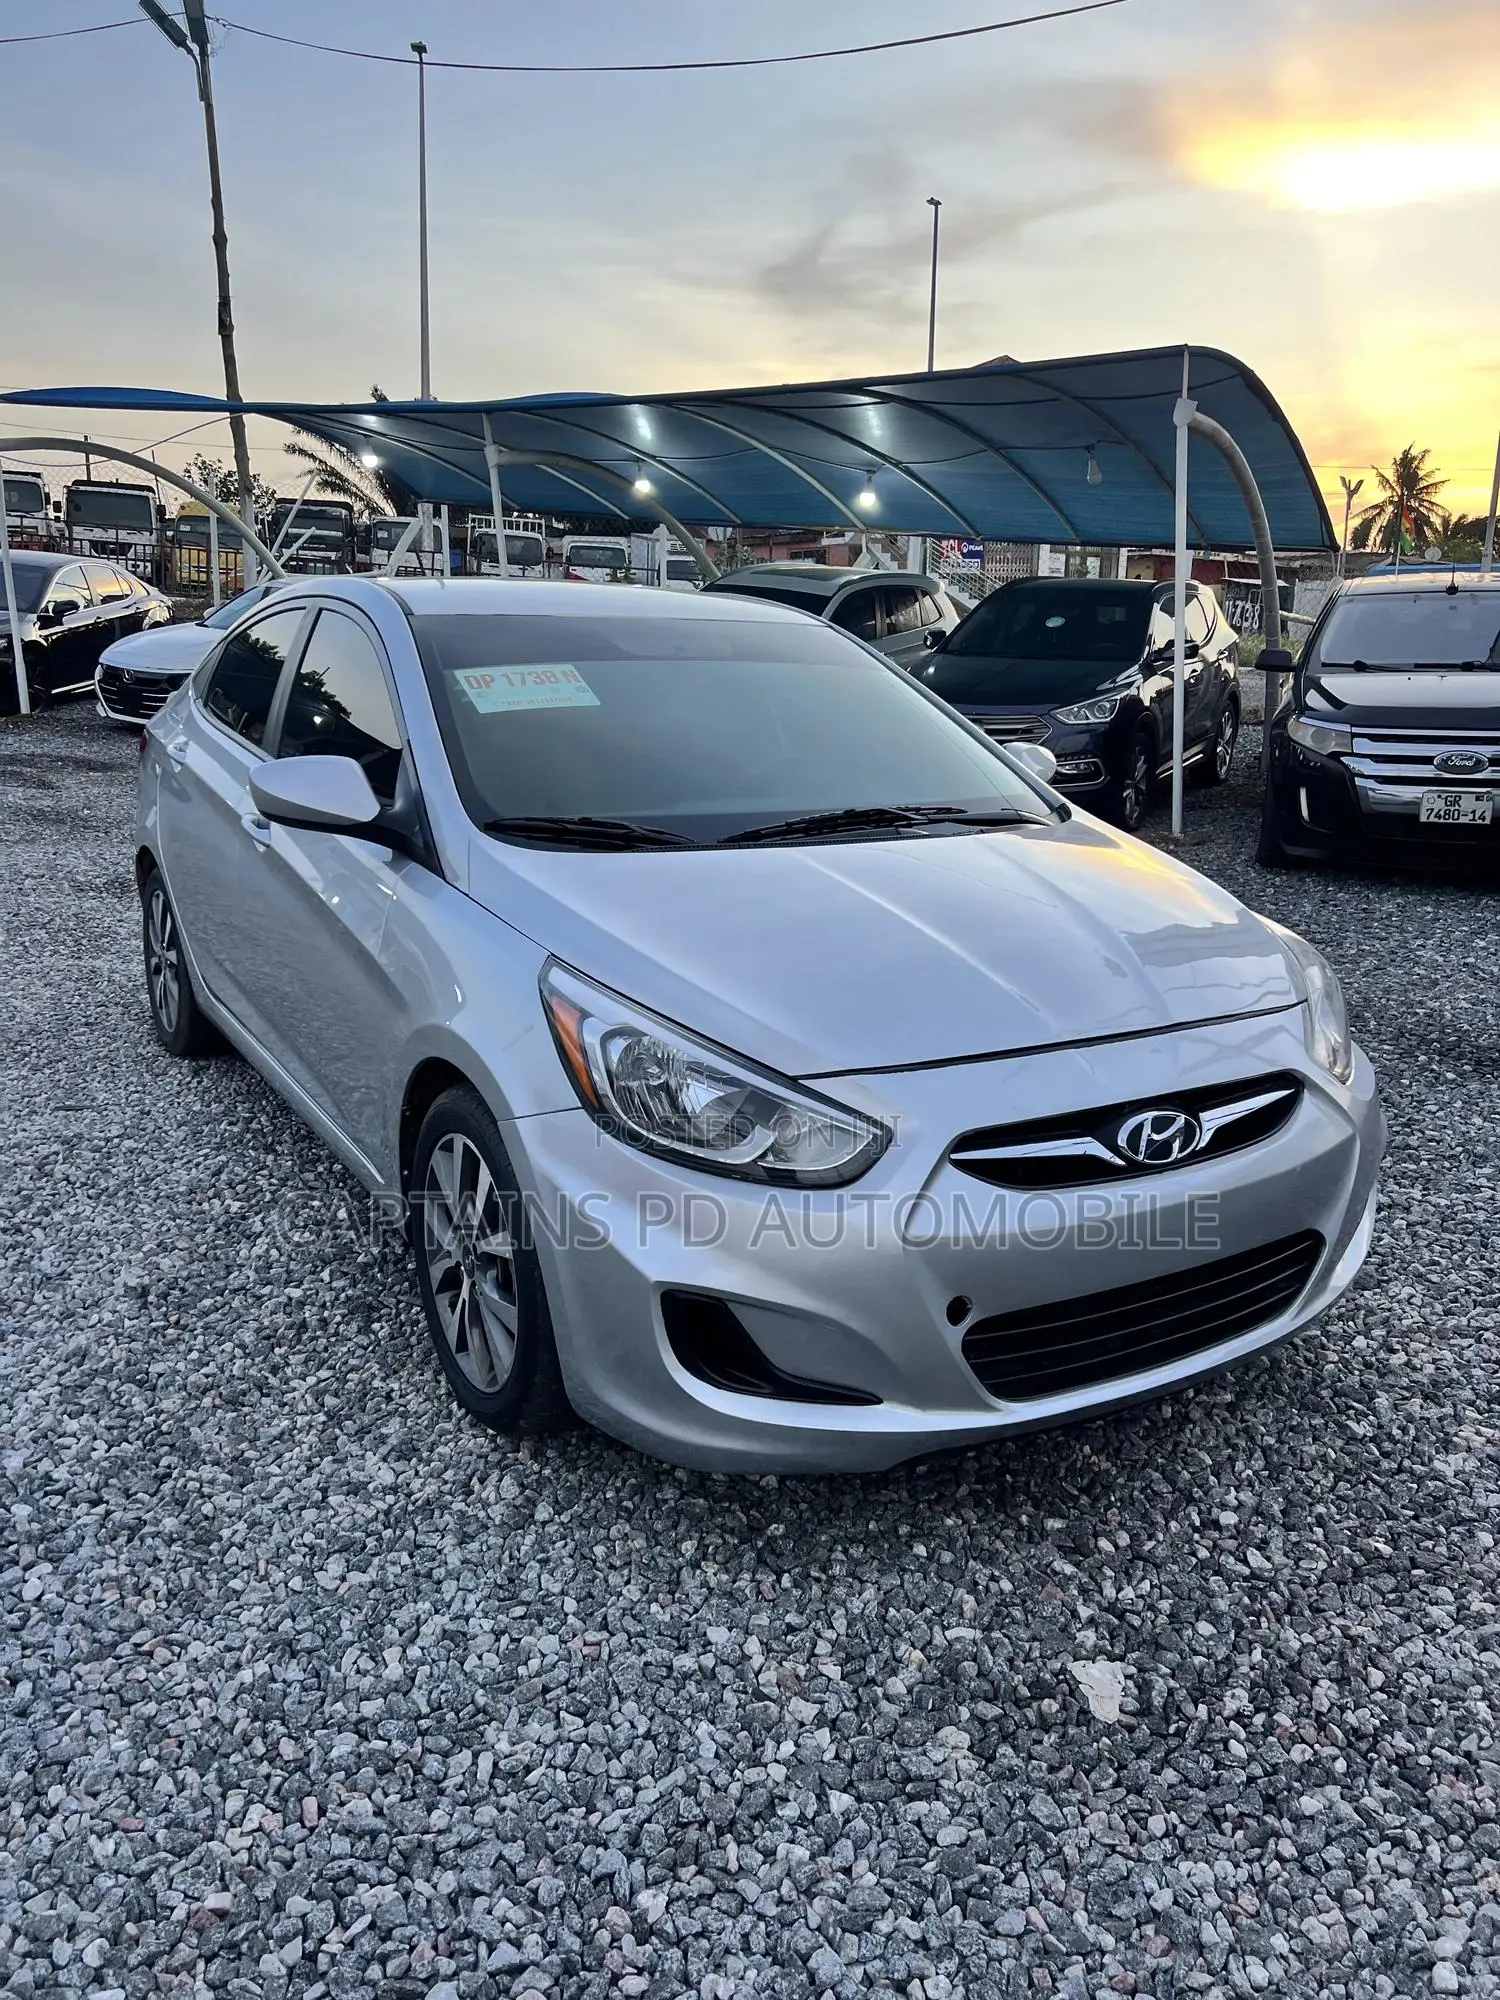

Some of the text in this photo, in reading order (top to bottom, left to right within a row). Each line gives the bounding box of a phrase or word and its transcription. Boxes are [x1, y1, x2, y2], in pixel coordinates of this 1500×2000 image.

[463, 674, 495, 690] DP
[500, 670, 561, 688] 1738
[1448, 756, 1476, 766] Ford
[1444, 795, 1462, 808] GR
[1426, 808, 1487, 822] 7480-14
